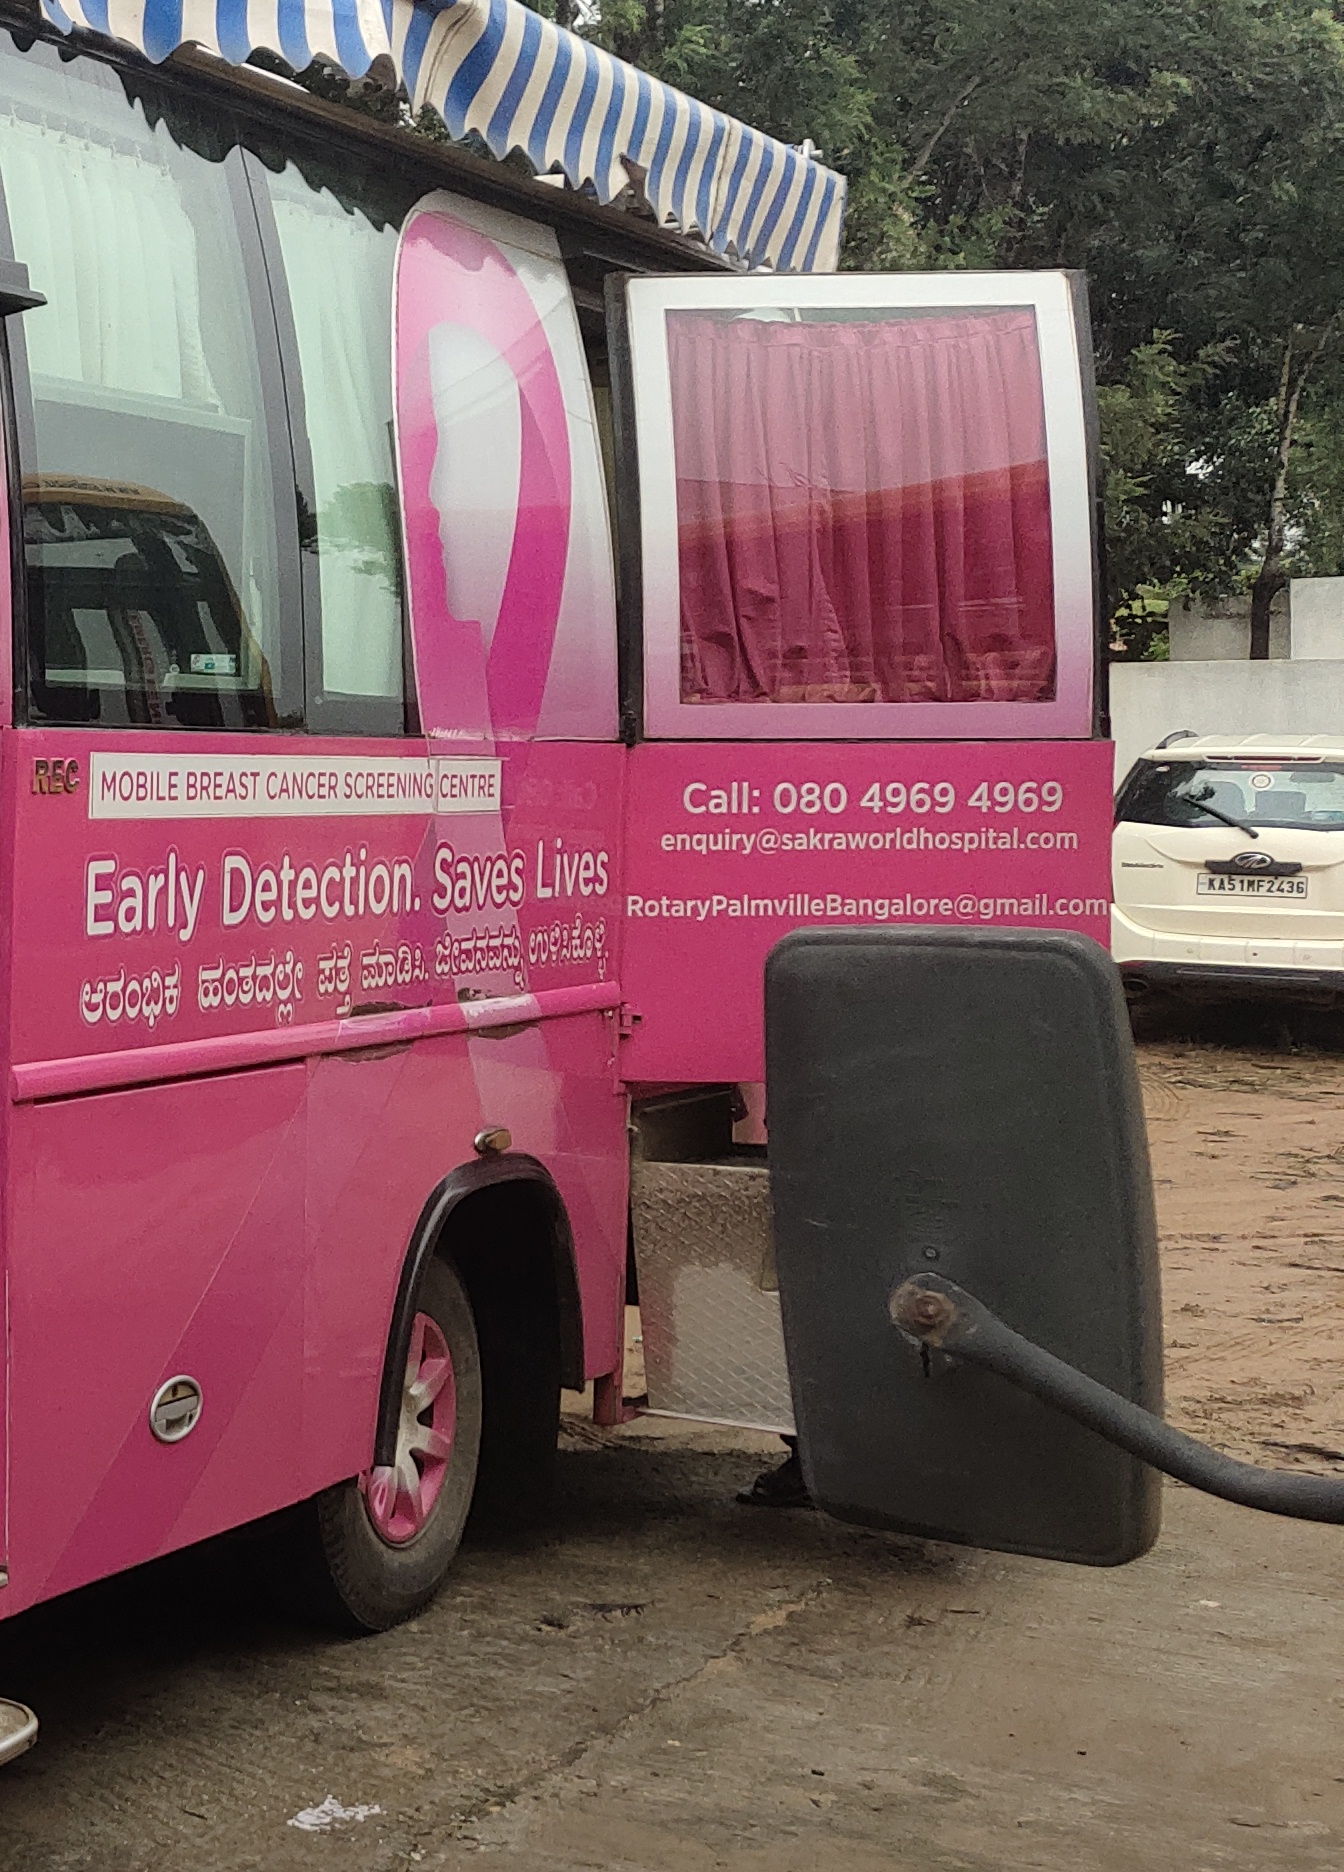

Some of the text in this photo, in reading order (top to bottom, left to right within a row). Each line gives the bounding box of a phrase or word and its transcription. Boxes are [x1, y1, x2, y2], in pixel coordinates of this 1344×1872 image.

[32, 758, 80, 795] REC
[100, 772, 179, 801] MOBILE
[186, 770, 261, 800] BREAST
[266, 768, 338, 798] CANCER
[343, 768, 434, 798] SCREENING
[439, 773, 496, 798] CENTRE
[683, 780, 1064, 814] Call: 080 4969 4969
[660, 826, 1079, 855] enquiry@sakraworldhospital.com
[86, 838, 609, 940] Early Detection. Saves Lives
[1207, 877, 1305, 894] KA51MF2436
[627, 893, 1108, 921] RotaryPalmvilleBangalore@gmail.com
[82, 965, 180, 1027] ಆರಂಭಿಕ
[199, 950, 304, 1024] ಹಂತದಲ್ಲೇ
[317, 943, 352, 1015] ಪತ್ತೆ
